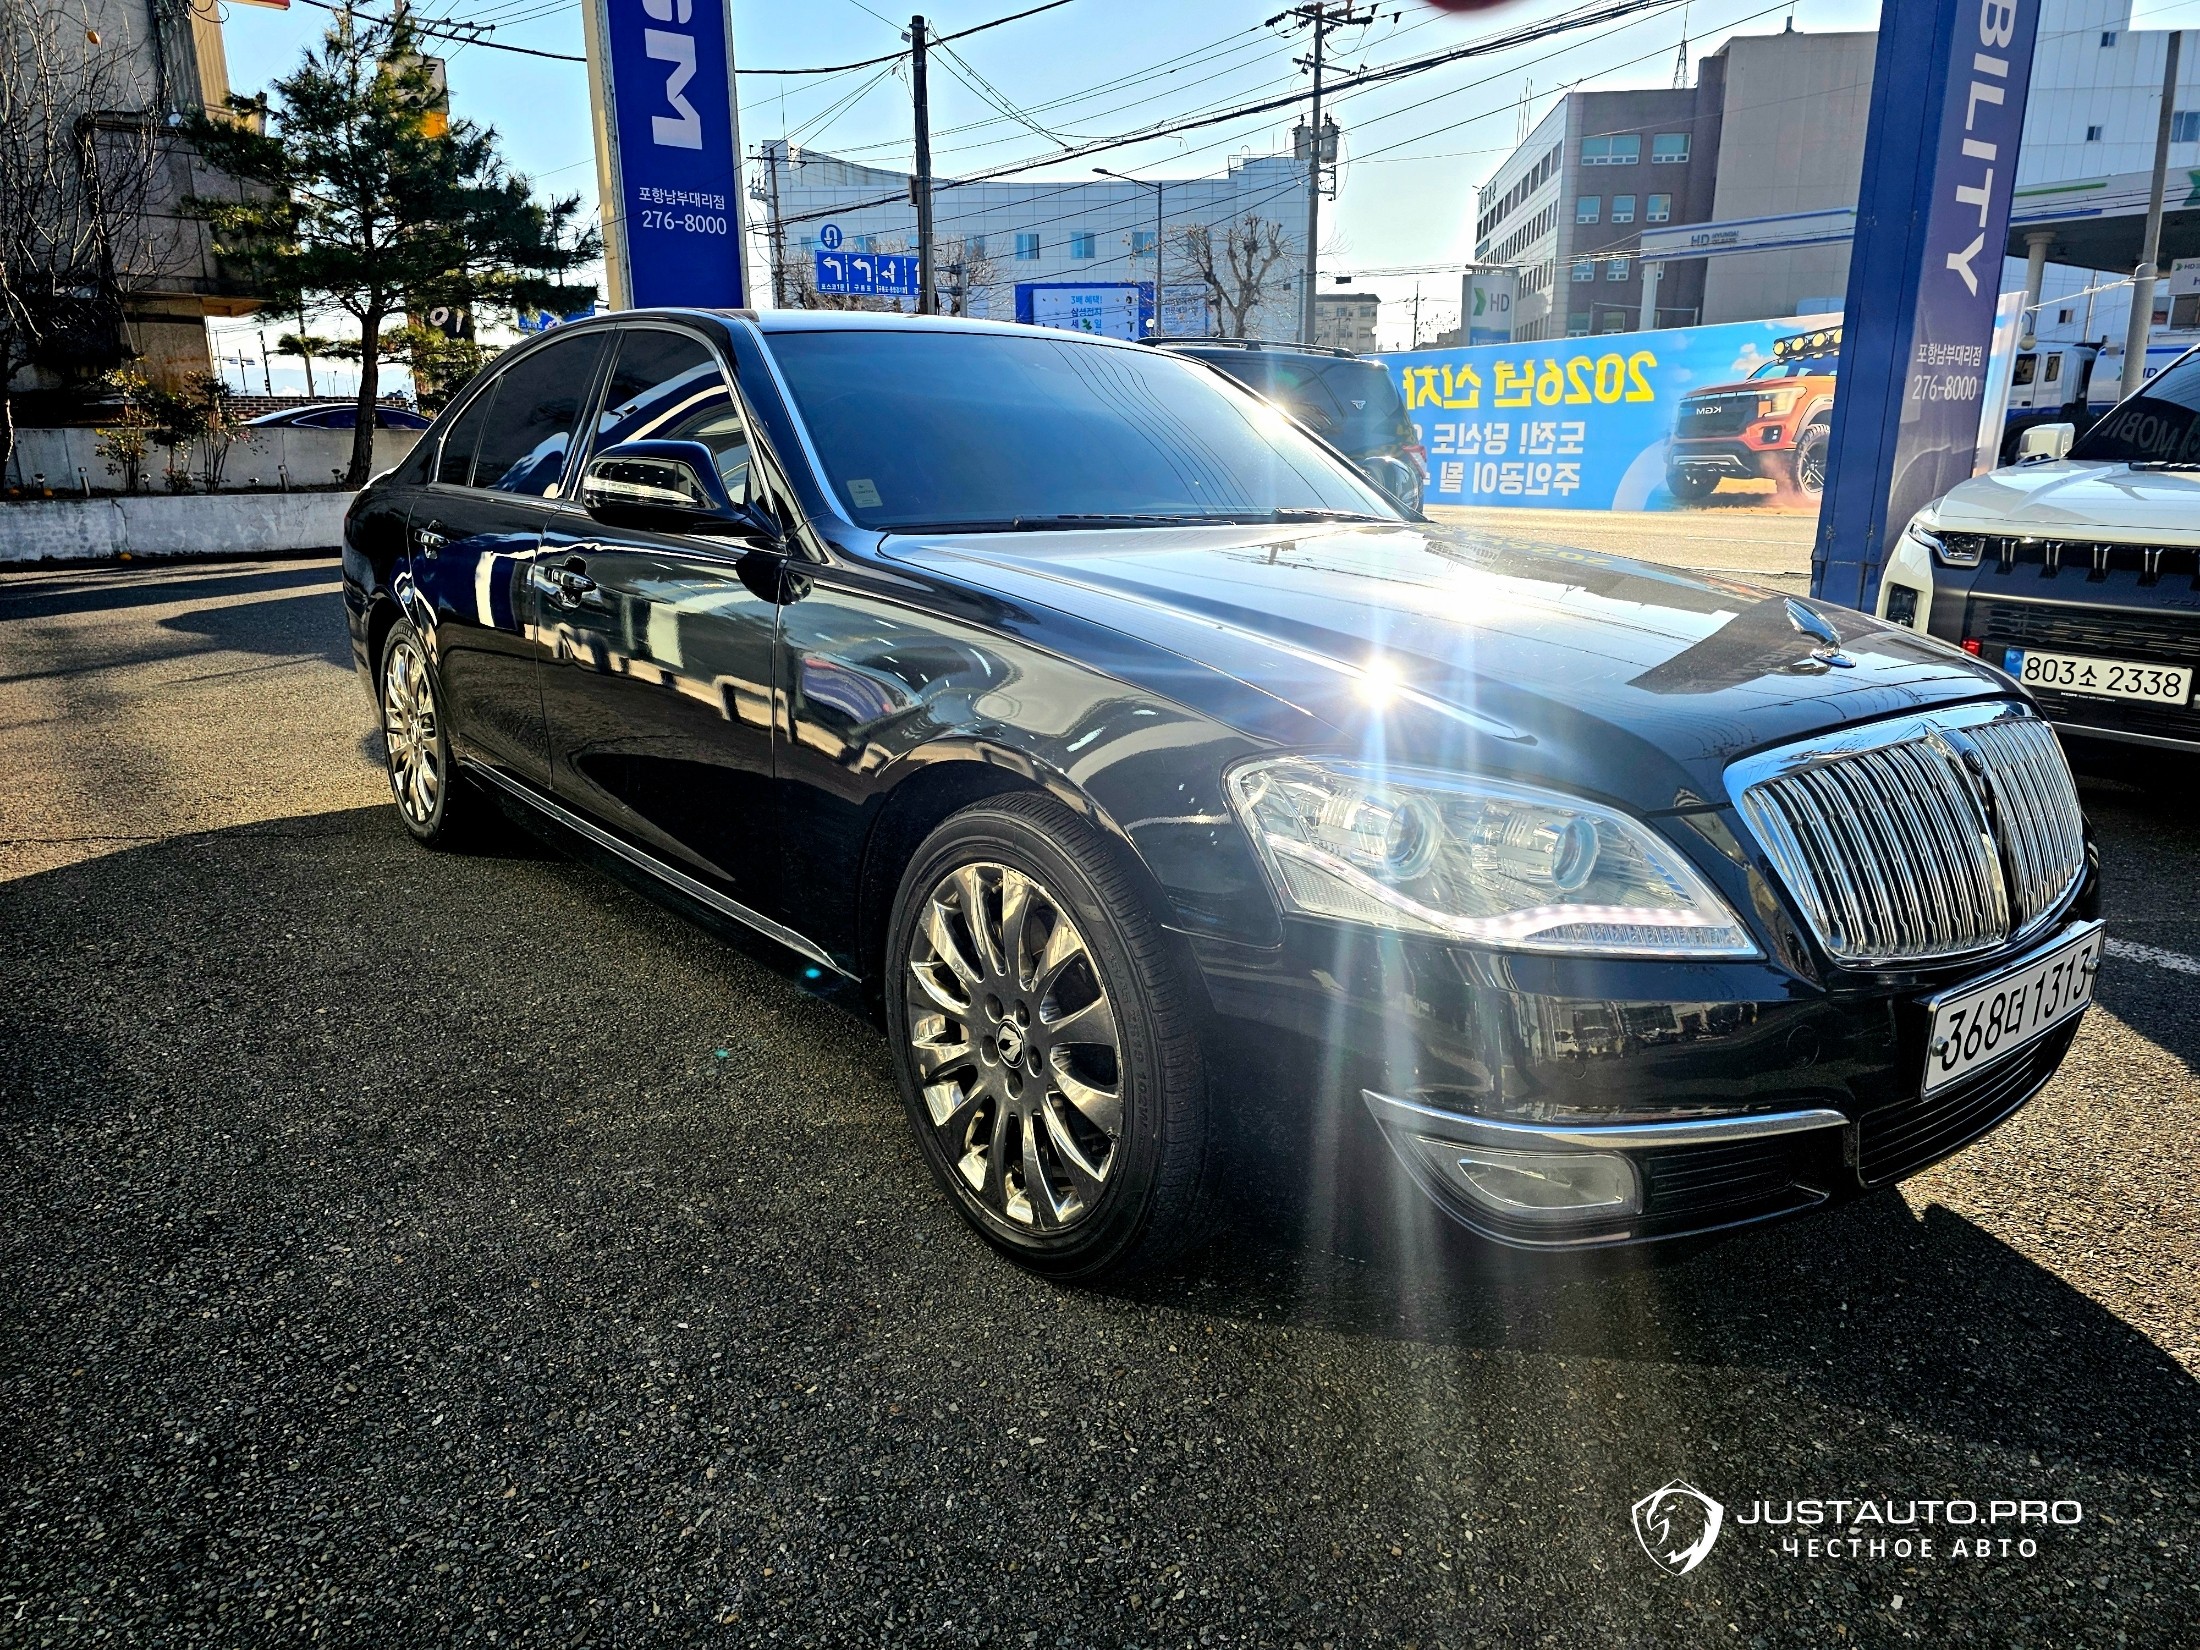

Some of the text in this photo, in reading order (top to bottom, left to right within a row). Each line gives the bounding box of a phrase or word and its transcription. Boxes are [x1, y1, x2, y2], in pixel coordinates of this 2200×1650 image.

[642, 0, 703, 150] M
[639, 187, 725, 210] 포항남부대리점
[642, 210, 727, 235] 276-8000
[1490, 293, 1510, 312] HD
[1916, 343, 1983, 367] 포항남부대리점
[1911, 374, 1977, 401] 276-8000
[2024, 656, 2182, 698] 803소 2338
[1941, 945, 2093, 1071] 368더 1313
